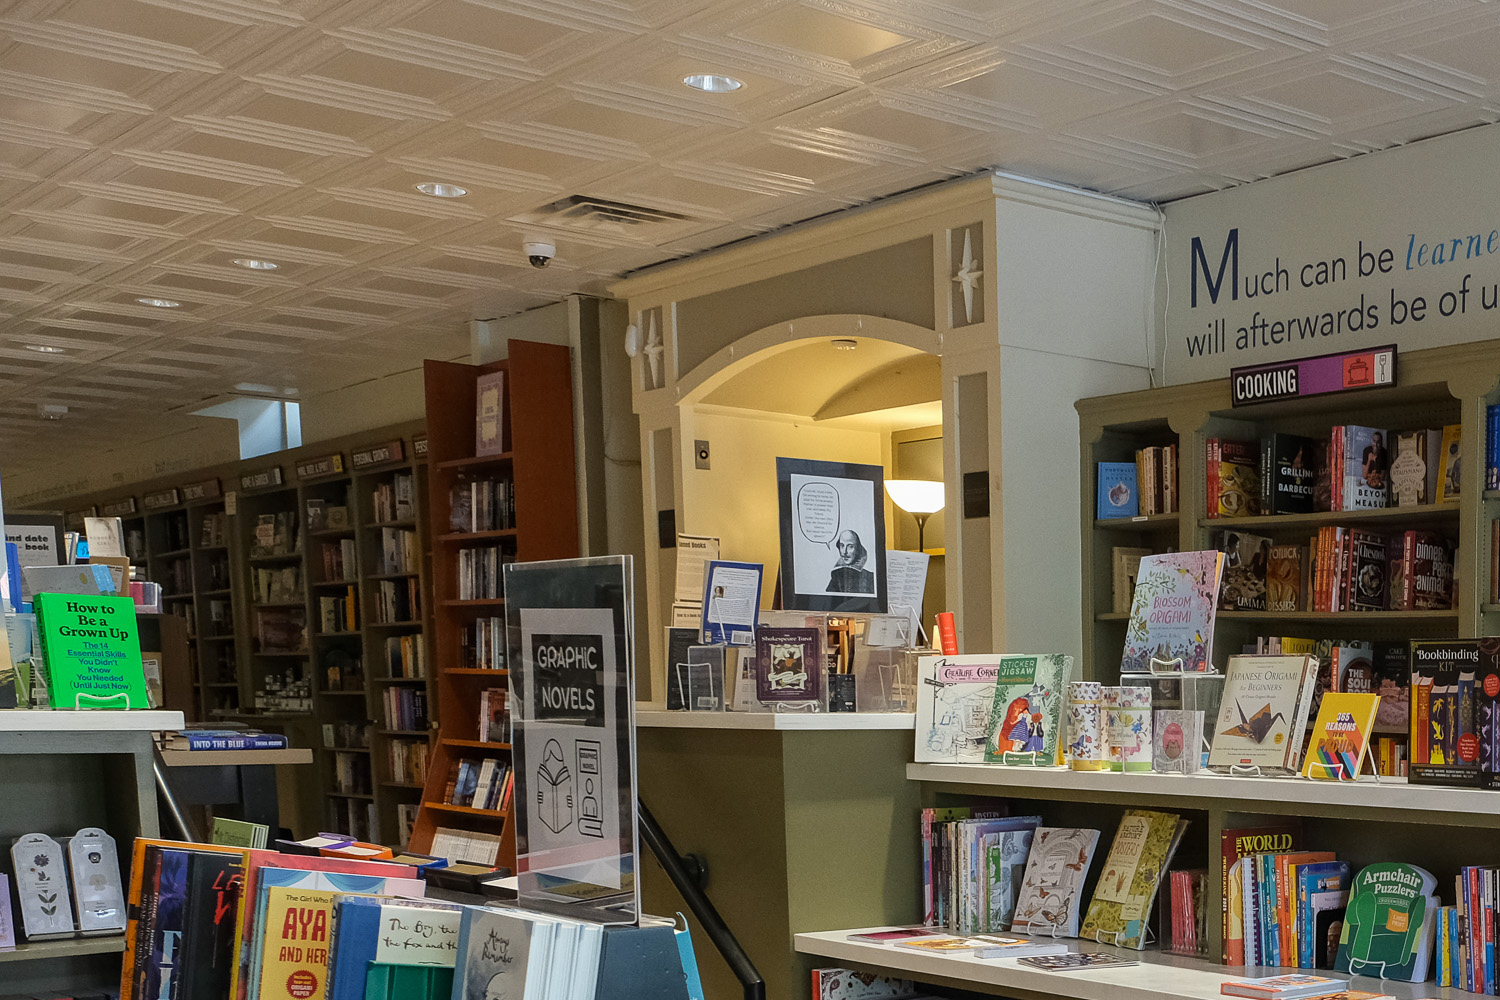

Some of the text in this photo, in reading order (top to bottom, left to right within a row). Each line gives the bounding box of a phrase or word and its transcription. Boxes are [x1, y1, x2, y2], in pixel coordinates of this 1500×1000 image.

[1191, 228, 1289, 308] Much
[1301, 257, 1346, 288] can
[1358, 241, 1394, 277] be
[1186, 318, 1225, 357] will
[1236, 294, 1378, 350] afterwards
[1391, 288, 1426, 325] be
[1439, 274, 1471, 317] of
[1236, 369, 1297, 400] COOKING
[29, 534, 49, 542] date
[26, 544, 49, 552] book
[67, 602, 114, 614] How to
[78, 615, 97, 625] Be
[1150, 609, 1191, 624] ORIGAMI
[59, 626, 128, 641] Grown Up
[1417, 649, 1479, 662] Bookbinding
[1002, 660, 1035, 668] STICKER
[1439, 662, 1454, 672] KIT
[1002, 667, 1034, 675] JIGSAW
[1230, 670, 1298, 681] JAPANESE ORIGAMI
[1248, 683, 1282, 692] BEGINNERS
[542, 686, 595, 711] NOVELS
[1337, 713, 1350, 722] 365
[1325, 722, 1356, 731] REASONS
[228, 740, 244, 748] BLUE
[1242, 834, 1293, 851] WORLD
[1363, 868, 1421, 888] Armchair
[1374, 884, 1417, 898] Puzzlers
[282, 907, 326, 942] AYA
[389, 918, 411, 931] The
[383, 938, 443, 950] the fox and
[279, 946, 327, 967] AND HER
